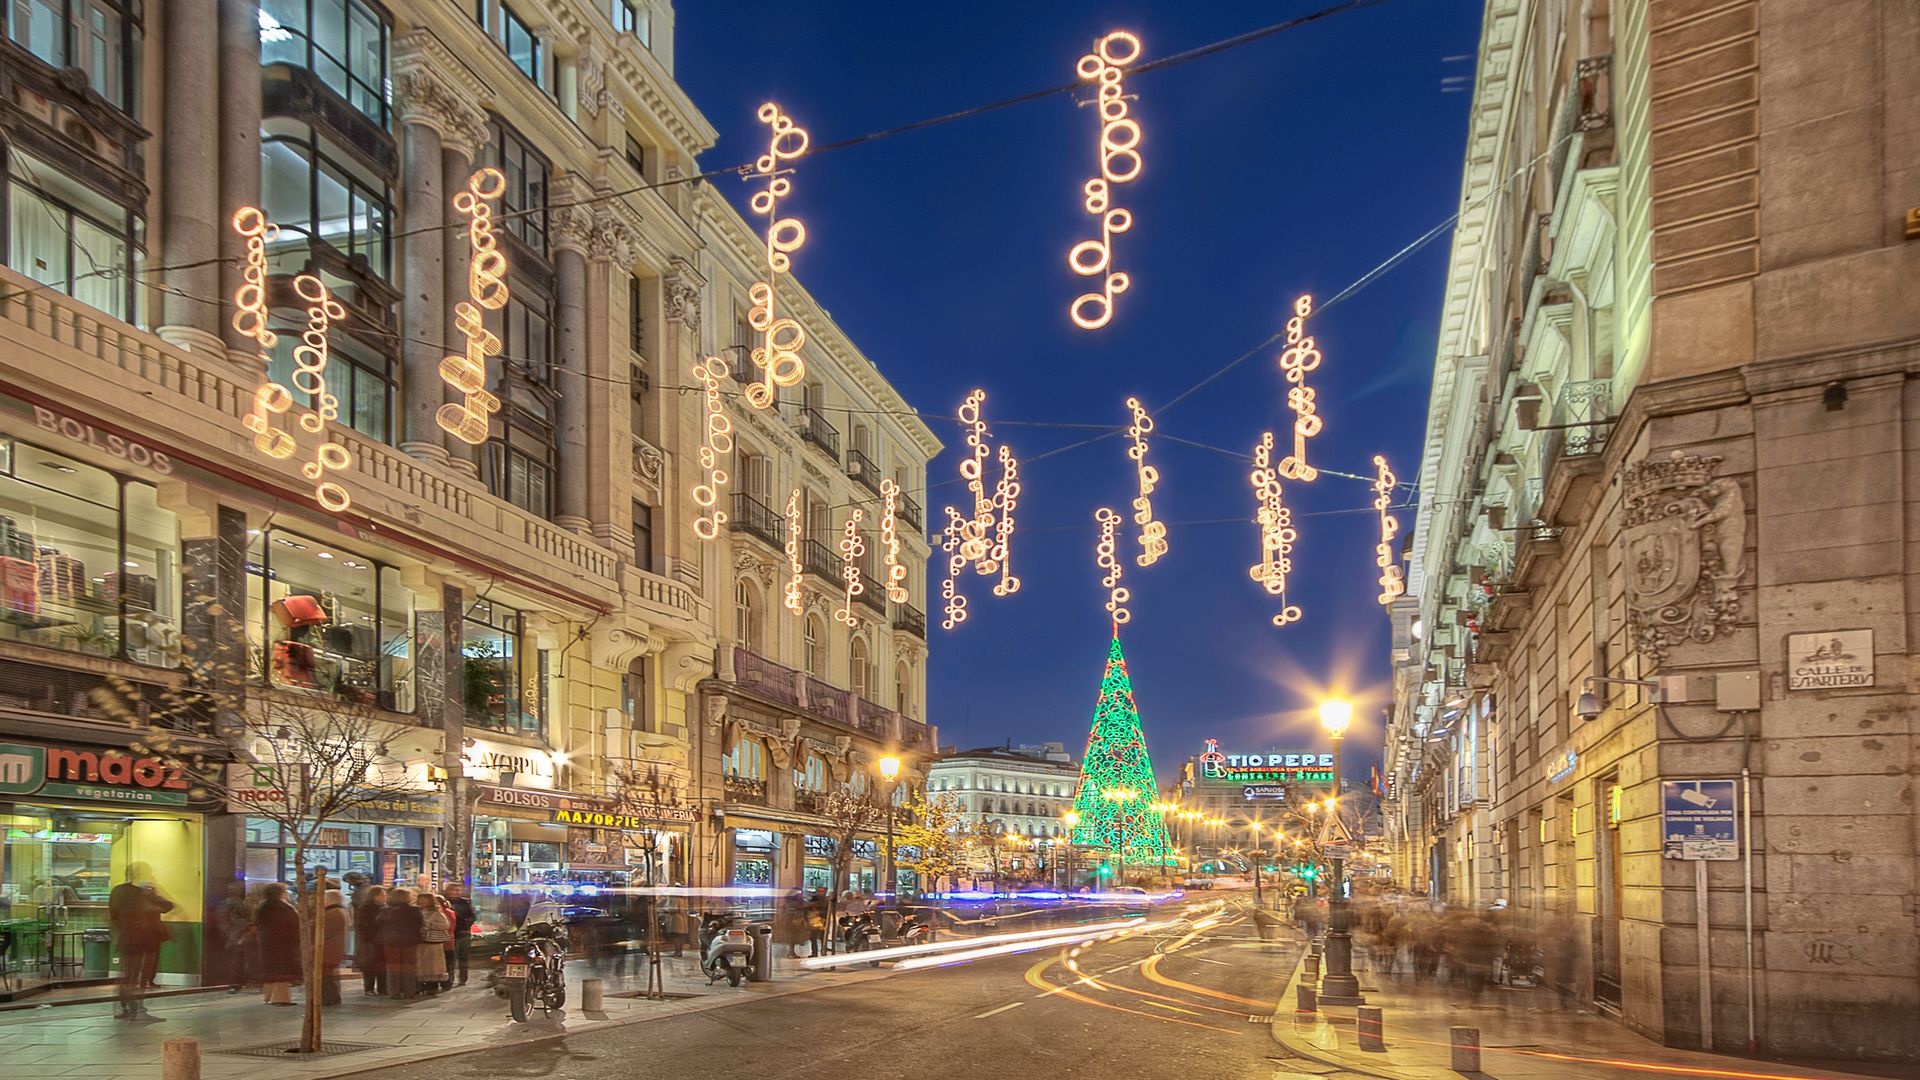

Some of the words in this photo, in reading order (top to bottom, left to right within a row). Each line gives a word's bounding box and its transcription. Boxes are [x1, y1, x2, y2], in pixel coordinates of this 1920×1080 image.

[33, 405, 173, 475] BOLSOS
[1795, 665, 1845, 676] CALLE
[1850, 665, 1866, 673] DE
[1791, 673, 1875, 688] ESPARTEROS
[1227, 755, 1263, 767] TIO
[1268, 754, 1334, 767] PEPE
[47, 748, 189, 789] maoz
[77, 787, 153, 800] vegetarian
[494, 789, 549, 807] BOLSOS
[392, 799, 407, 811] del
